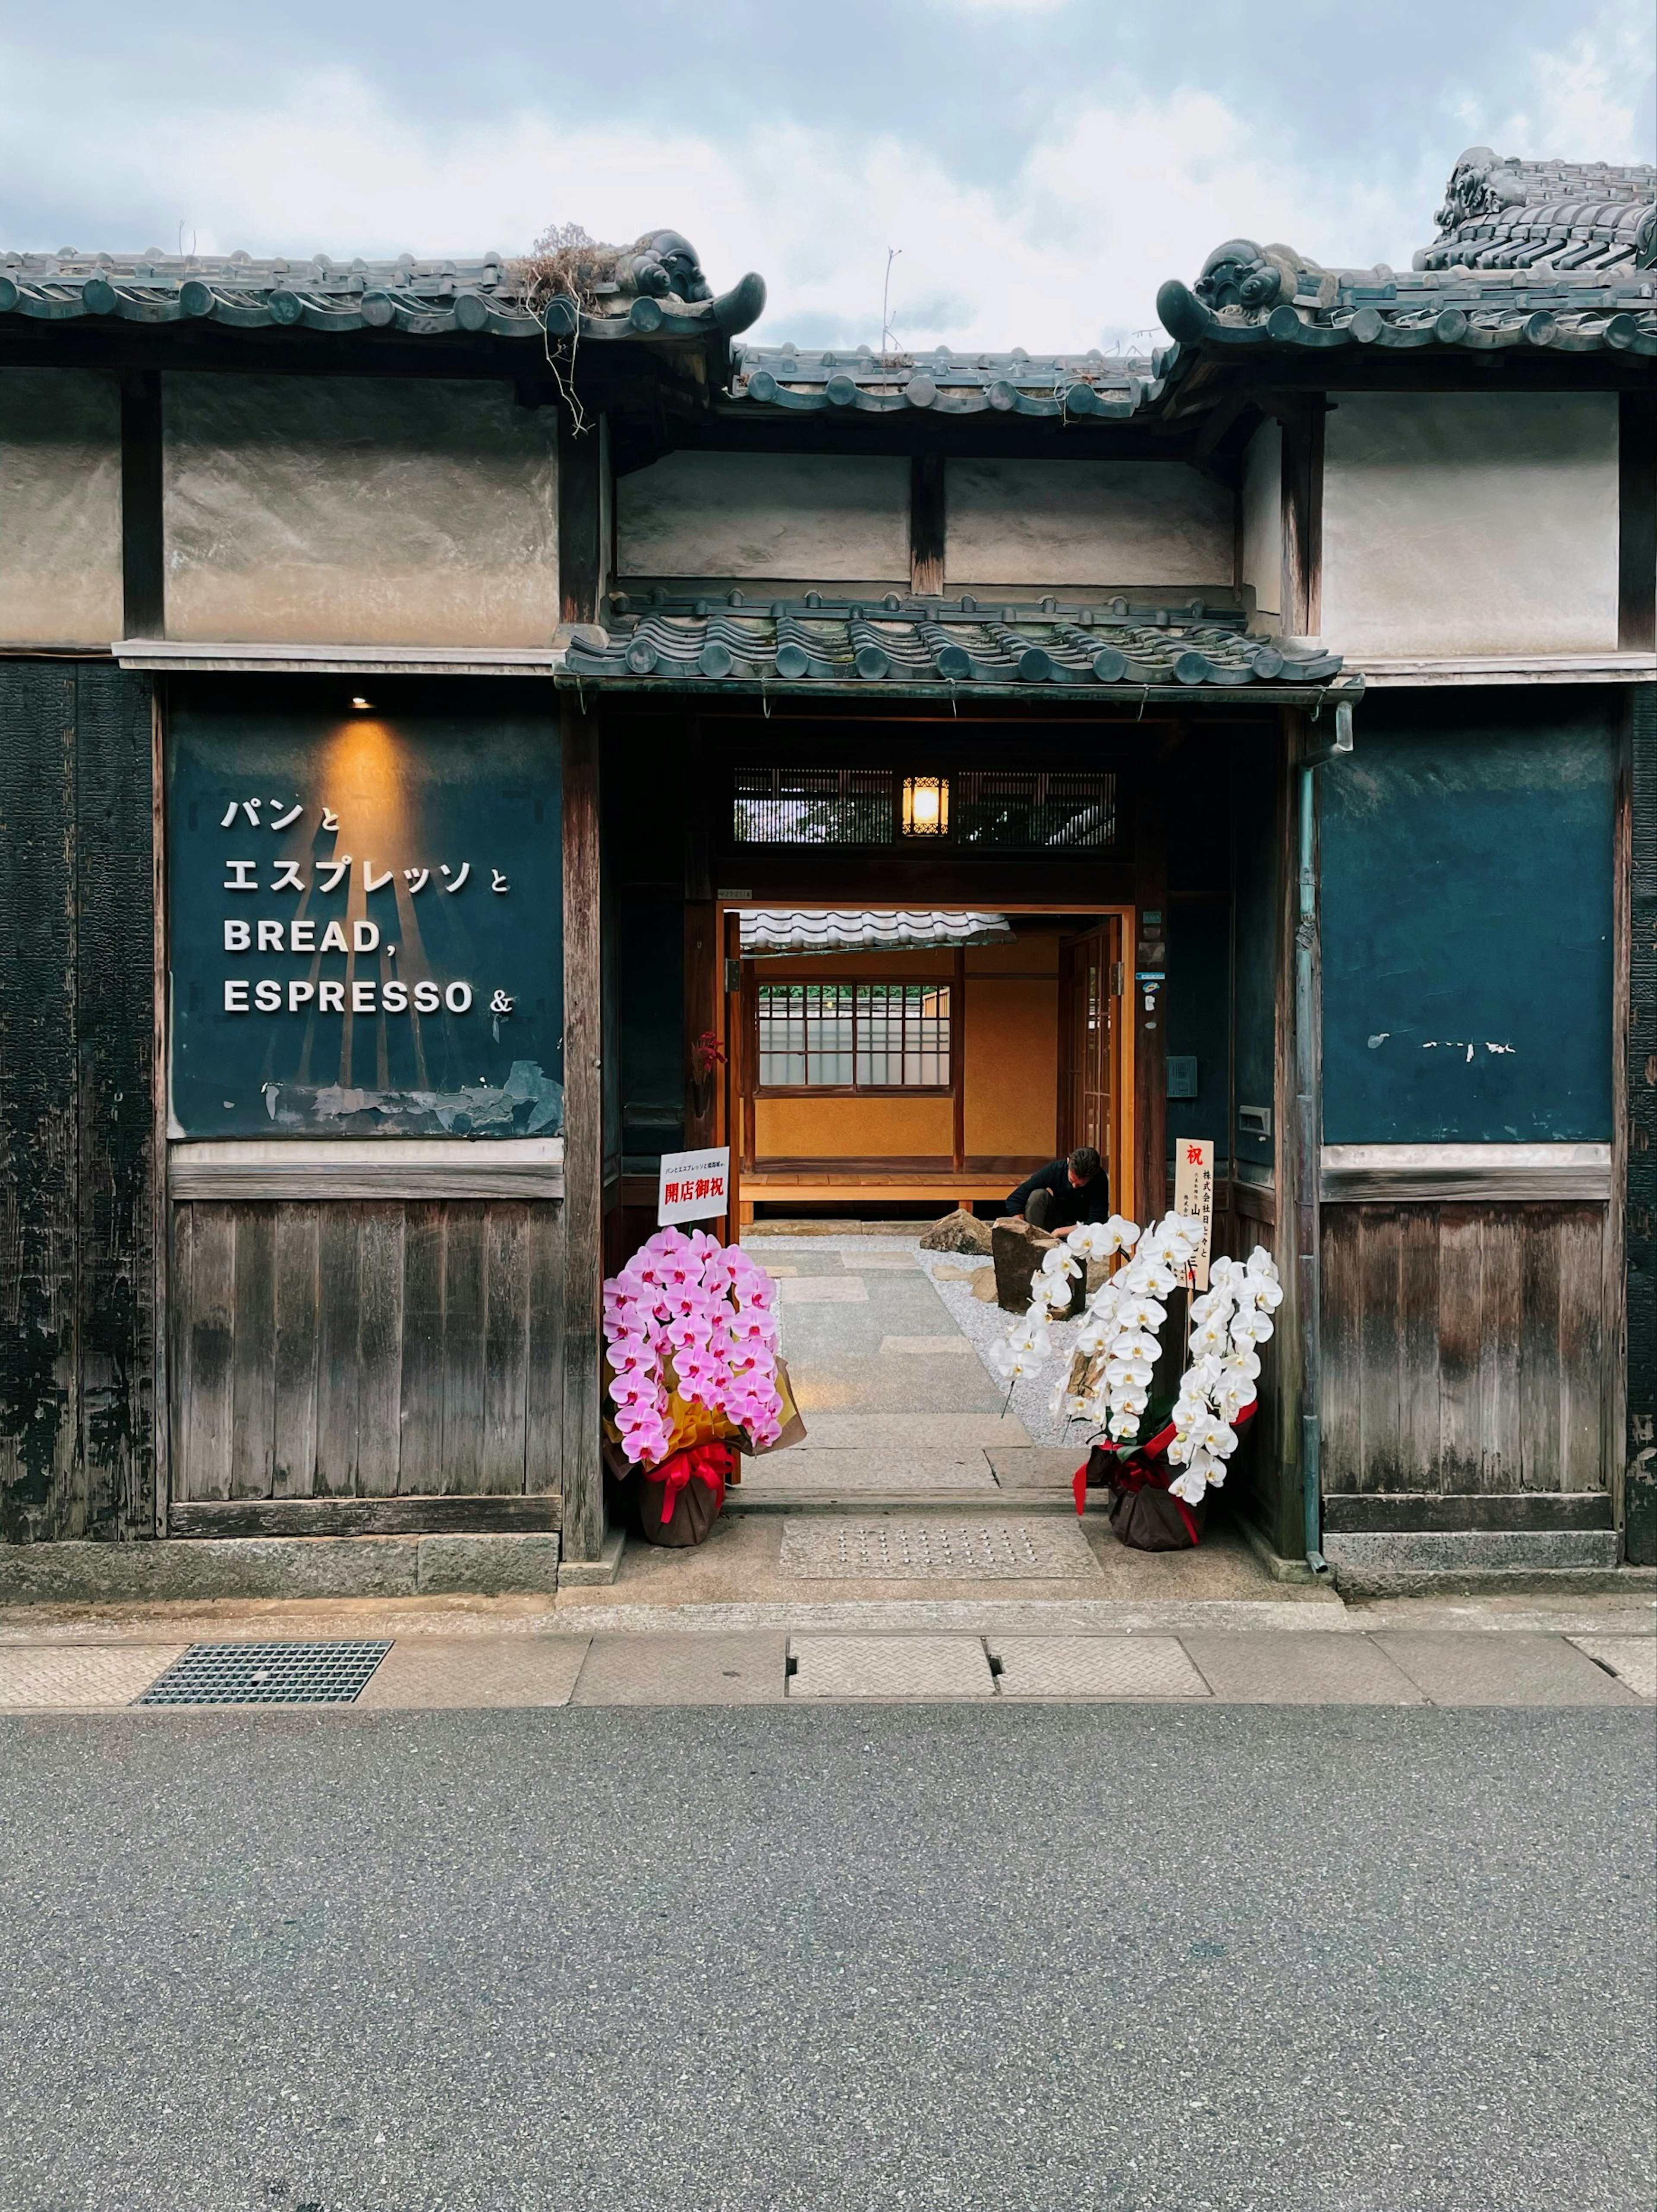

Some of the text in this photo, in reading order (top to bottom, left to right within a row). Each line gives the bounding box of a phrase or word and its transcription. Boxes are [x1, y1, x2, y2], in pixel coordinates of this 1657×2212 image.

[221, 797, 340, 831] パンと
[224, 854, 509, 894] エスプレッソと
[224, 920, 396, 957] BREAD,
[224, 980, 513, 1013] ESPRESSO &
[1187, 1144, 1203, 1166] 祝
[665, 1177, 724, 1205] 開店御祝
